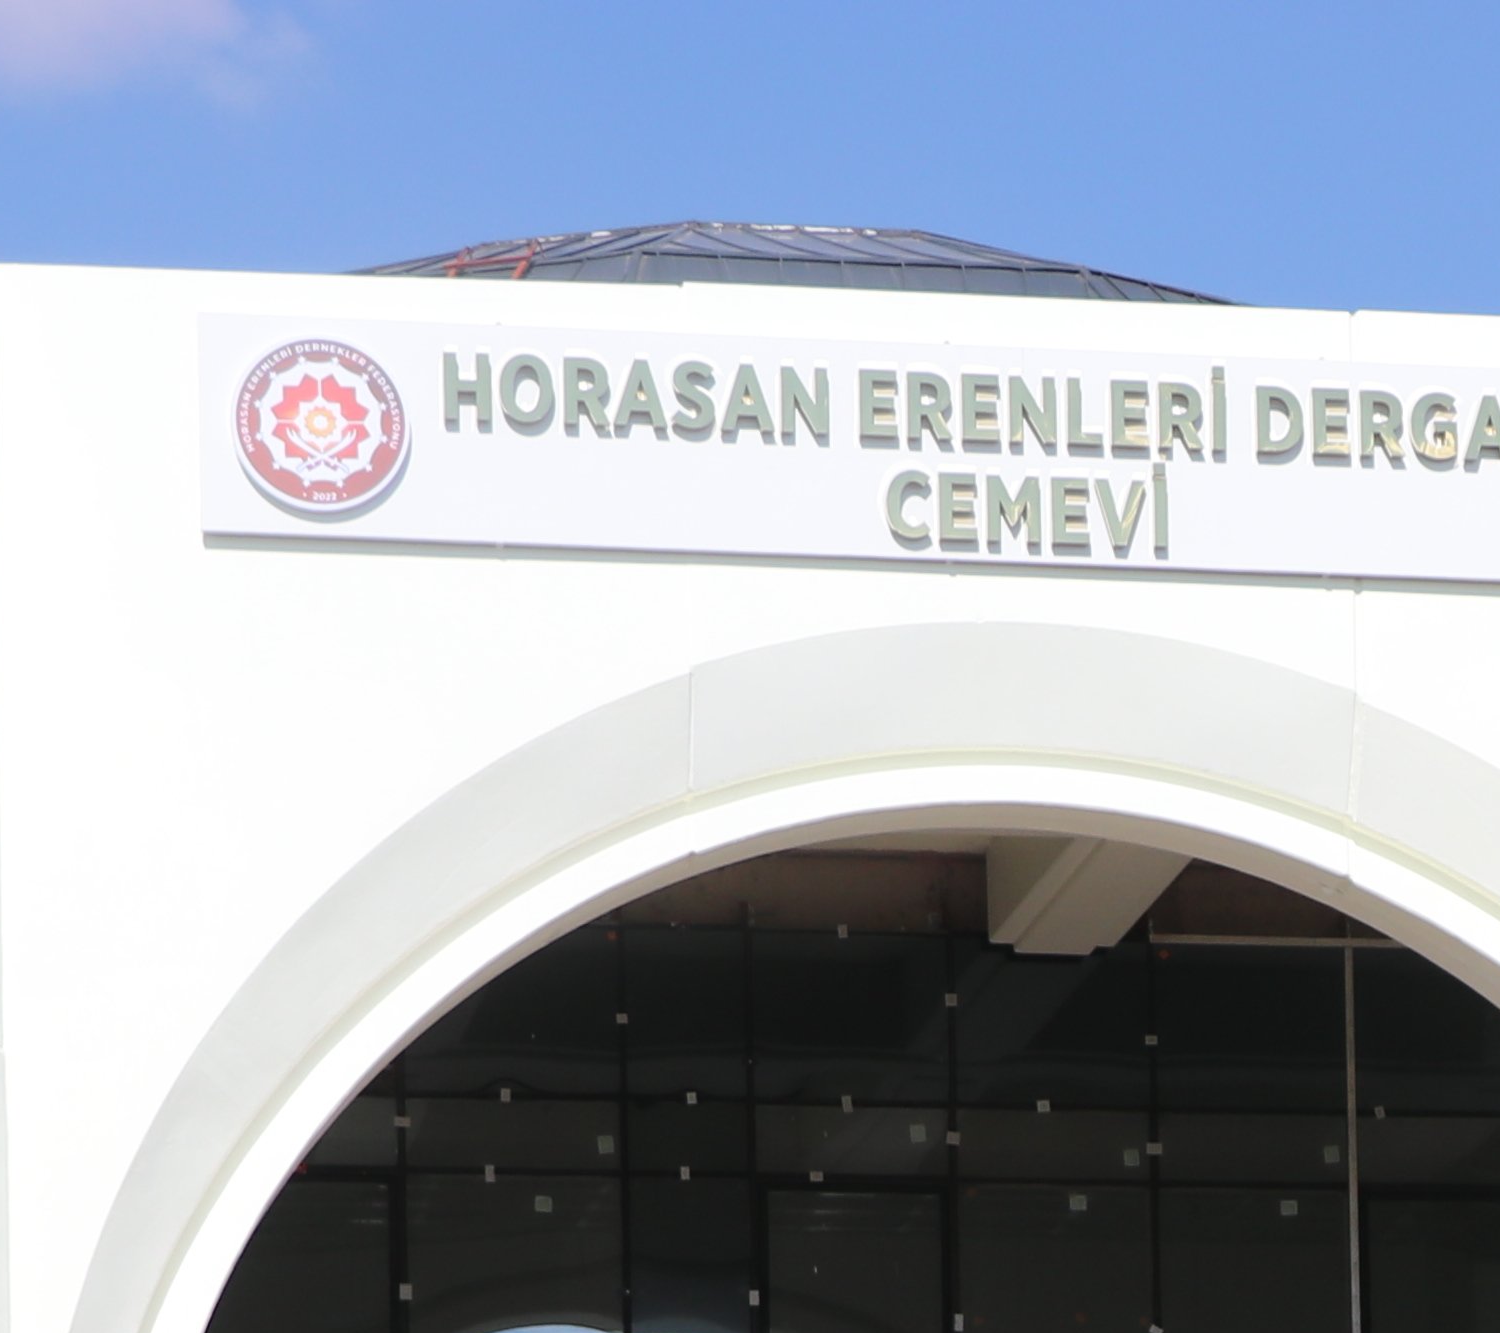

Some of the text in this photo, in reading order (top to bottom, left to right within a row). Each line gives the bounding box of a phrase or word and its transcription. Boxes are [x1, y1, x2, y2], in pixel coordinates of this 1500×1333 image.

[295, 342, 367, 368] DERNEKLER
[366, 363, 401, 450] FEDERASYONU
[443, 351, 830, 446] HORASAN
[859, 365, 1227, 462] ERENLERİ
[885, 462, 1169, 559] CEMEVİ
